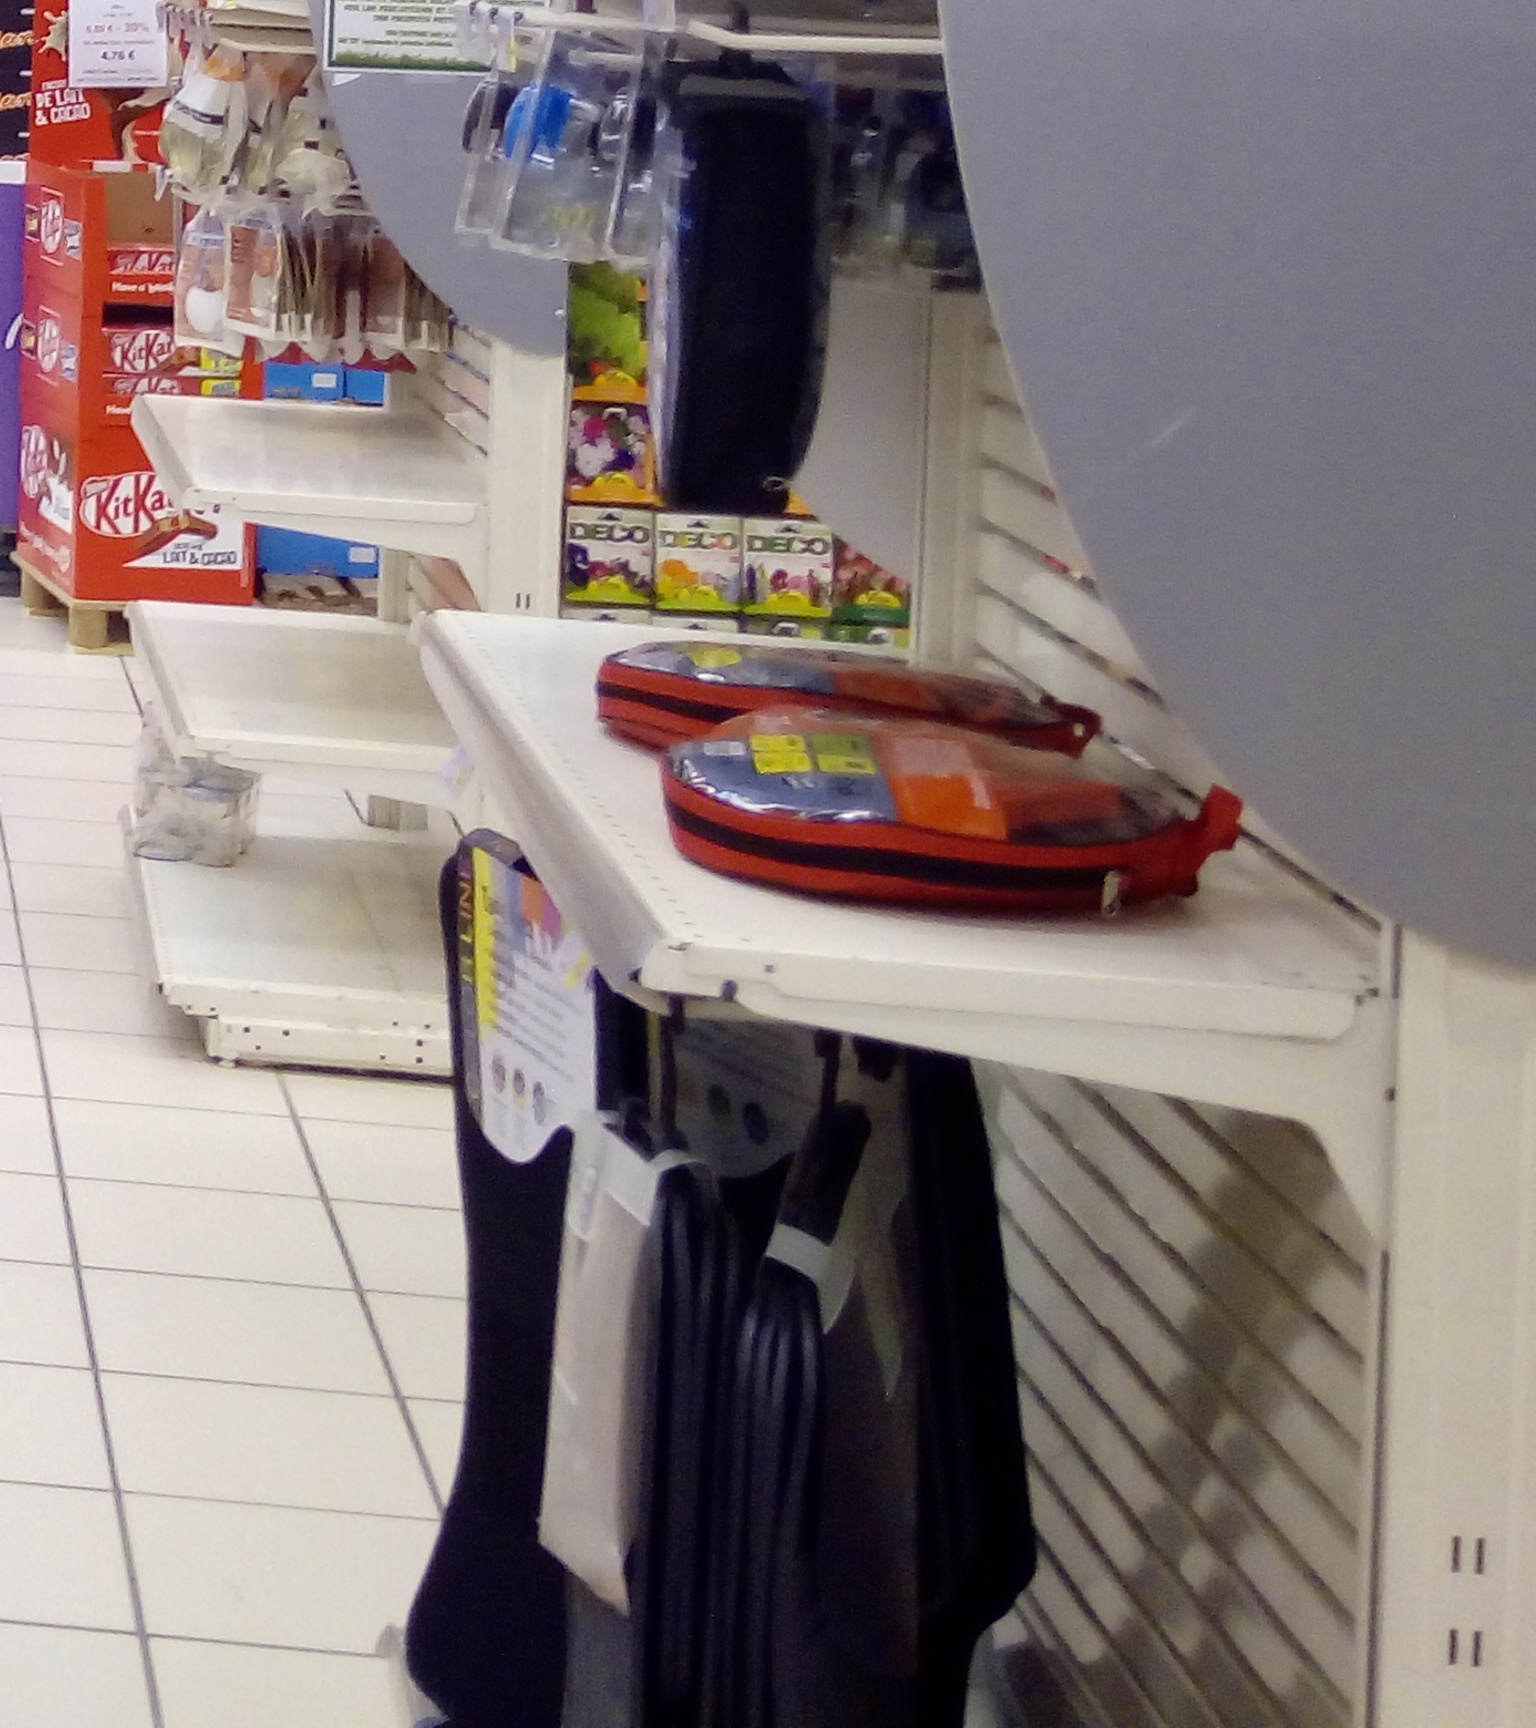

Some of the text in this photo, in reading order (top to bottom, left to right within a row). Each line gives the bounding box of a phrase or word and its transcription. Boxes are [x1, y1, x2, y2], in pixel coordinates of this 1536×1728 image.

[35, 92, 54, 109] DE
[35, 109, 49, 126] &
[96, 474, 174, 535] KitKa
[570, 523, 650, 545] DECO
[658, 531, 739, 550] DECO
[746, 535, 830, 555] DECO
[163, 551, 186, 565] LAIT
[190, 552, 200, 565] &
